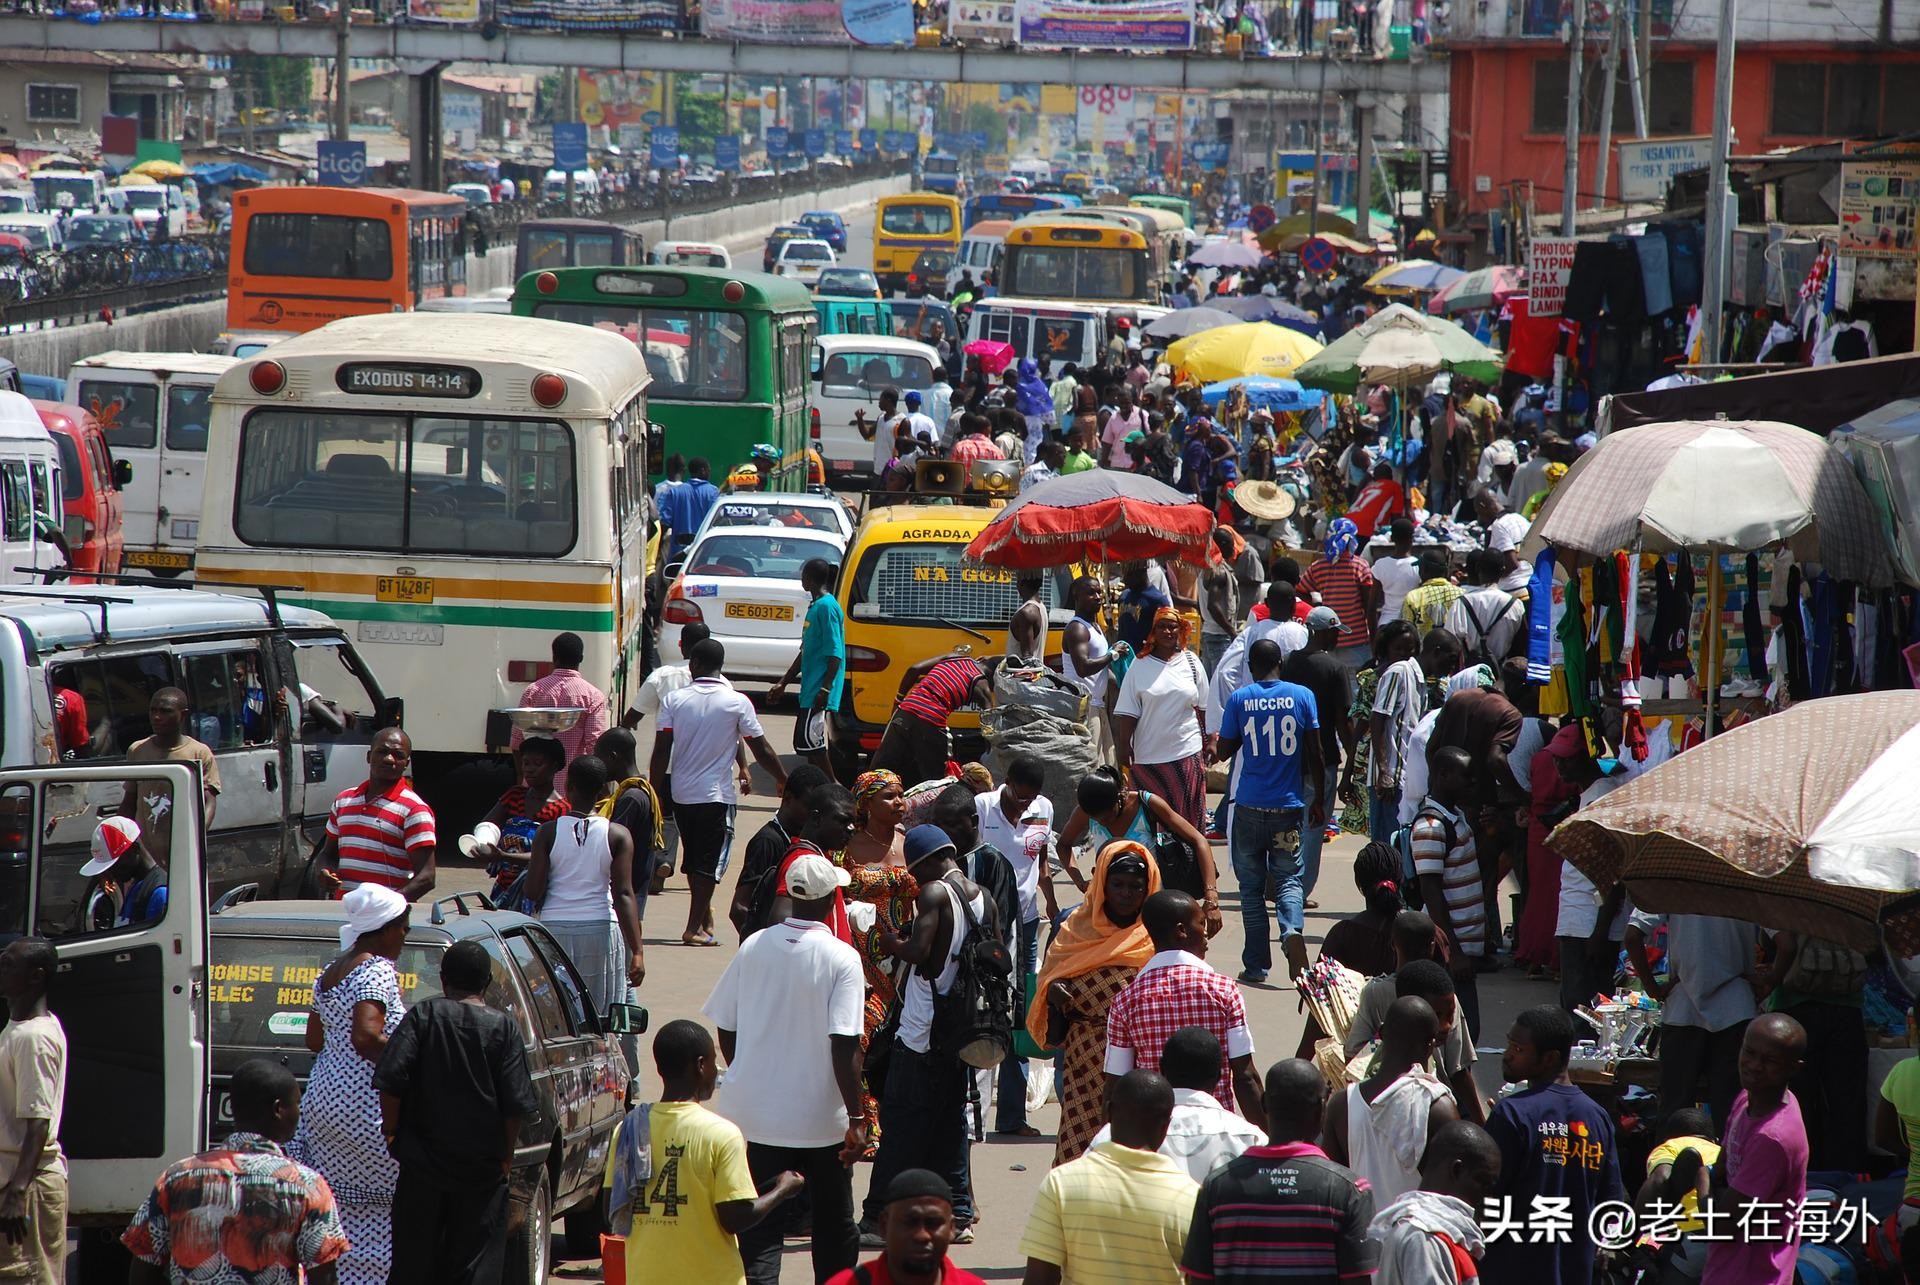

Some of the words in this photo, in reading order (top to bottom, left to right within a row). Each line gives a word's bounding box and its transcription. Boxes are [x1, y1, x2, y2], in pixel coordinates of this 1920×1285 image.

[1640, 145, 1695, 160] INSANIYYA
[320, 151, 365, 183] tigo
[1532, 272, 1558, 284] FAX
[353, 370, 414, 387] EXODUS
[420, 373, 462, 390] 14:14
[725, 505, 753, 515] TAXI
[902, 529, 972, 539] AGRADAA
[129, 553, 145, 565] AS
[148, 554, 171, 566] 5183
[174, 555, 182, 567] X
[914, 567, 949, 582] NA
[378, 578, 393, 593] GT
[395, 579, 422, 595] 1428
[423, 580, 432, 595] F
[728, 605, 745, 617] GE
[748, 606, 773, 618] 6031
[776, 607, 784, 619] Z
[364, 623, 436, 642] TATA
[1243, 696, 1295, 712] MICCRO
[1243, 714, 1297, 757] 118
